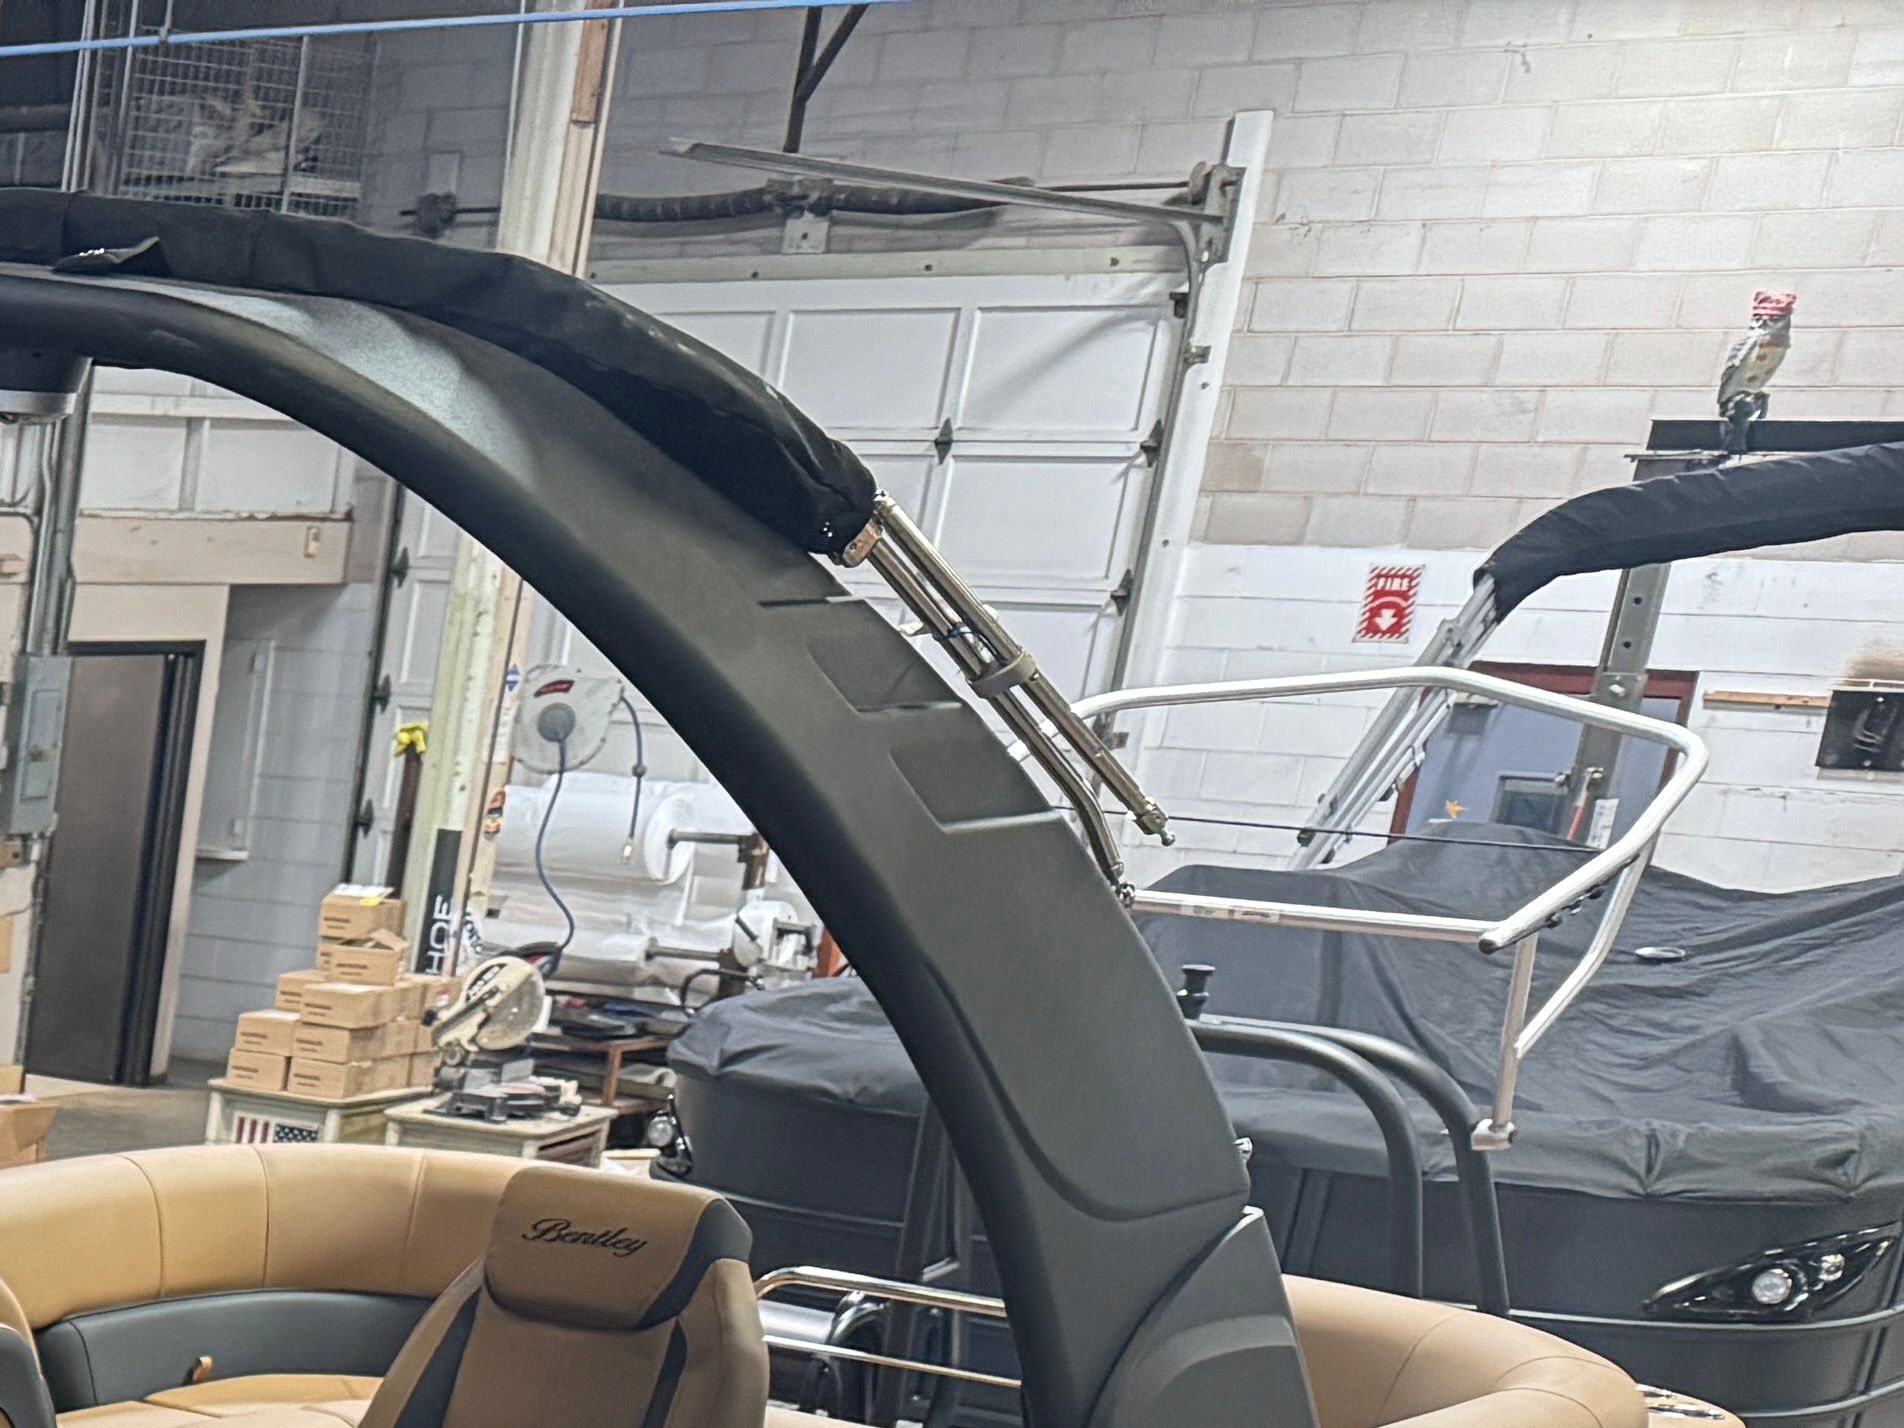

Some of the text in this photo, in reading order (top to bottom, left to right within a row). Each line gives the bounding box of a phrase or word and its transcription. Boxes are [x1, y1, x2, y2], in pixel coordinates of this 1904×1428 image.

[1376, 577, 1410, 590] FIRE
[426, 894, 452, 974] HOE
[521, 1218, 648, 1257] Bentley
